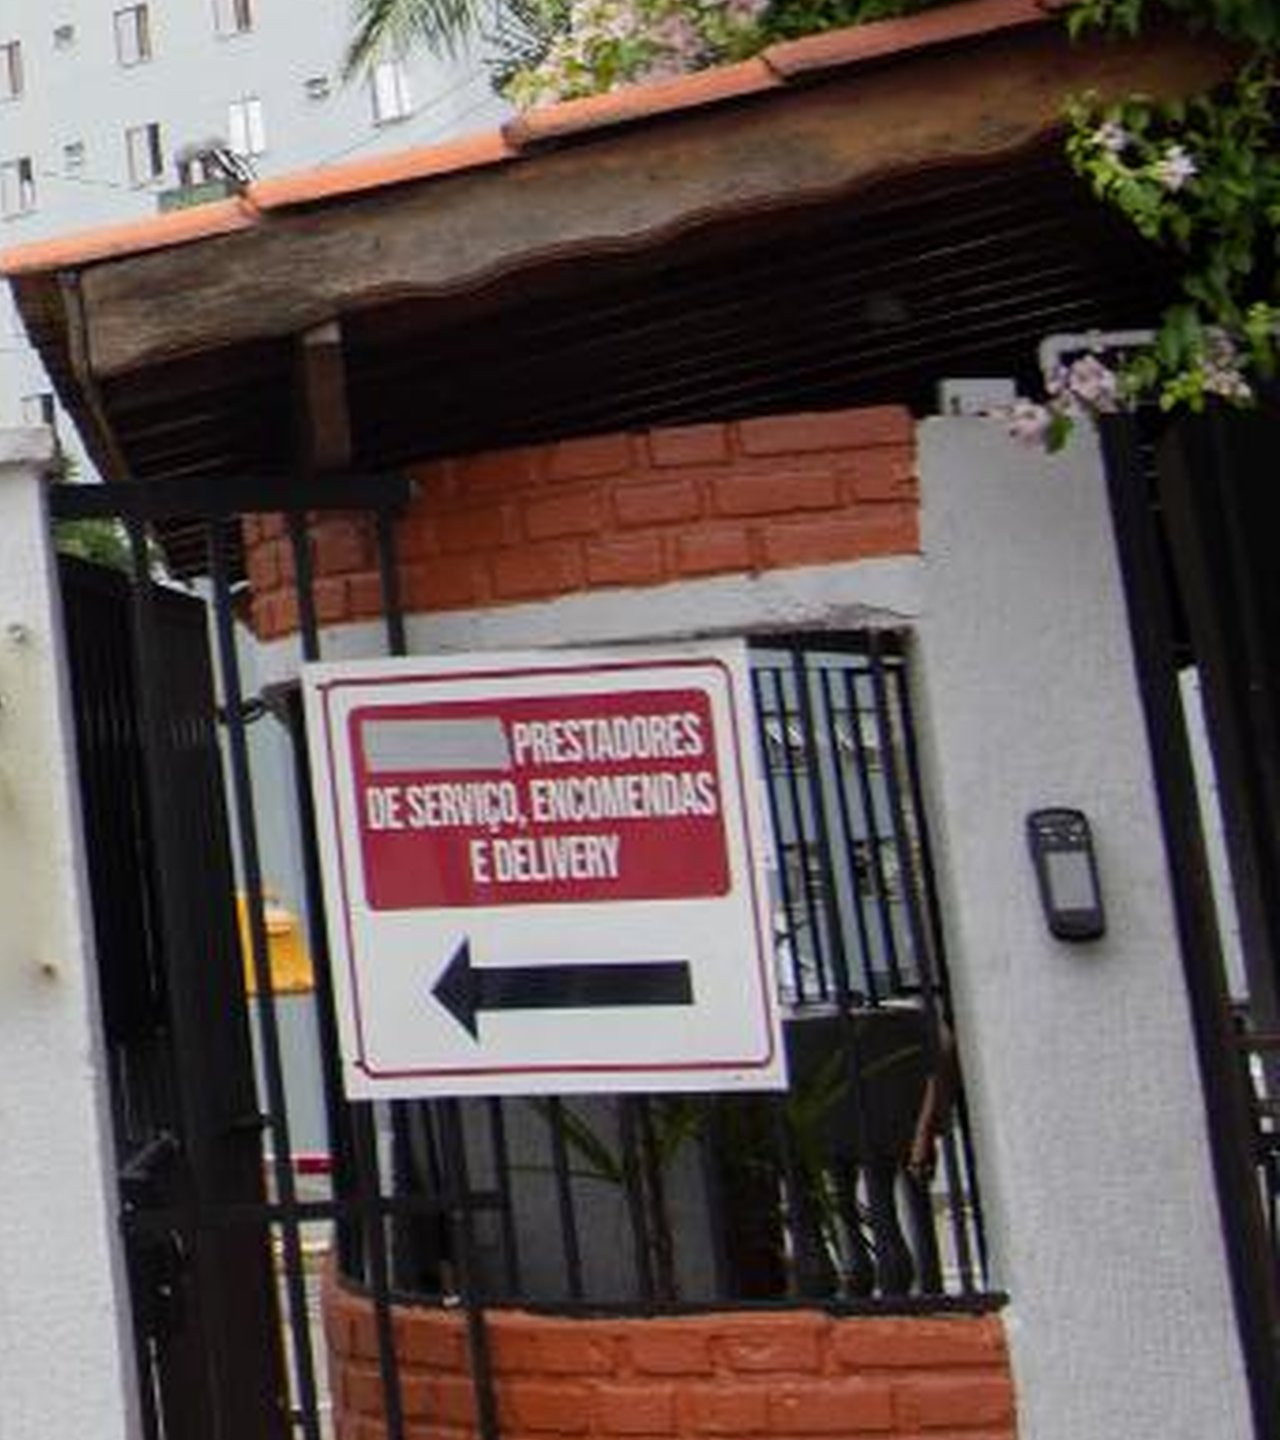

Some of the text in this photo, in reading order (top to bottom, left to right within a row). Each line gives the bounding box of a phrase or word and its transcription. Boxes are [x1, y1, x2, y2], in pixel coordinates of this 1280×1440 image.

[513, 714, 703, 764] PRESTADORES
[367, 772, 716, 834] DE SERVIÇO, ENCOMENDAS
[471, 835, 620, 883] E DELIVERY
